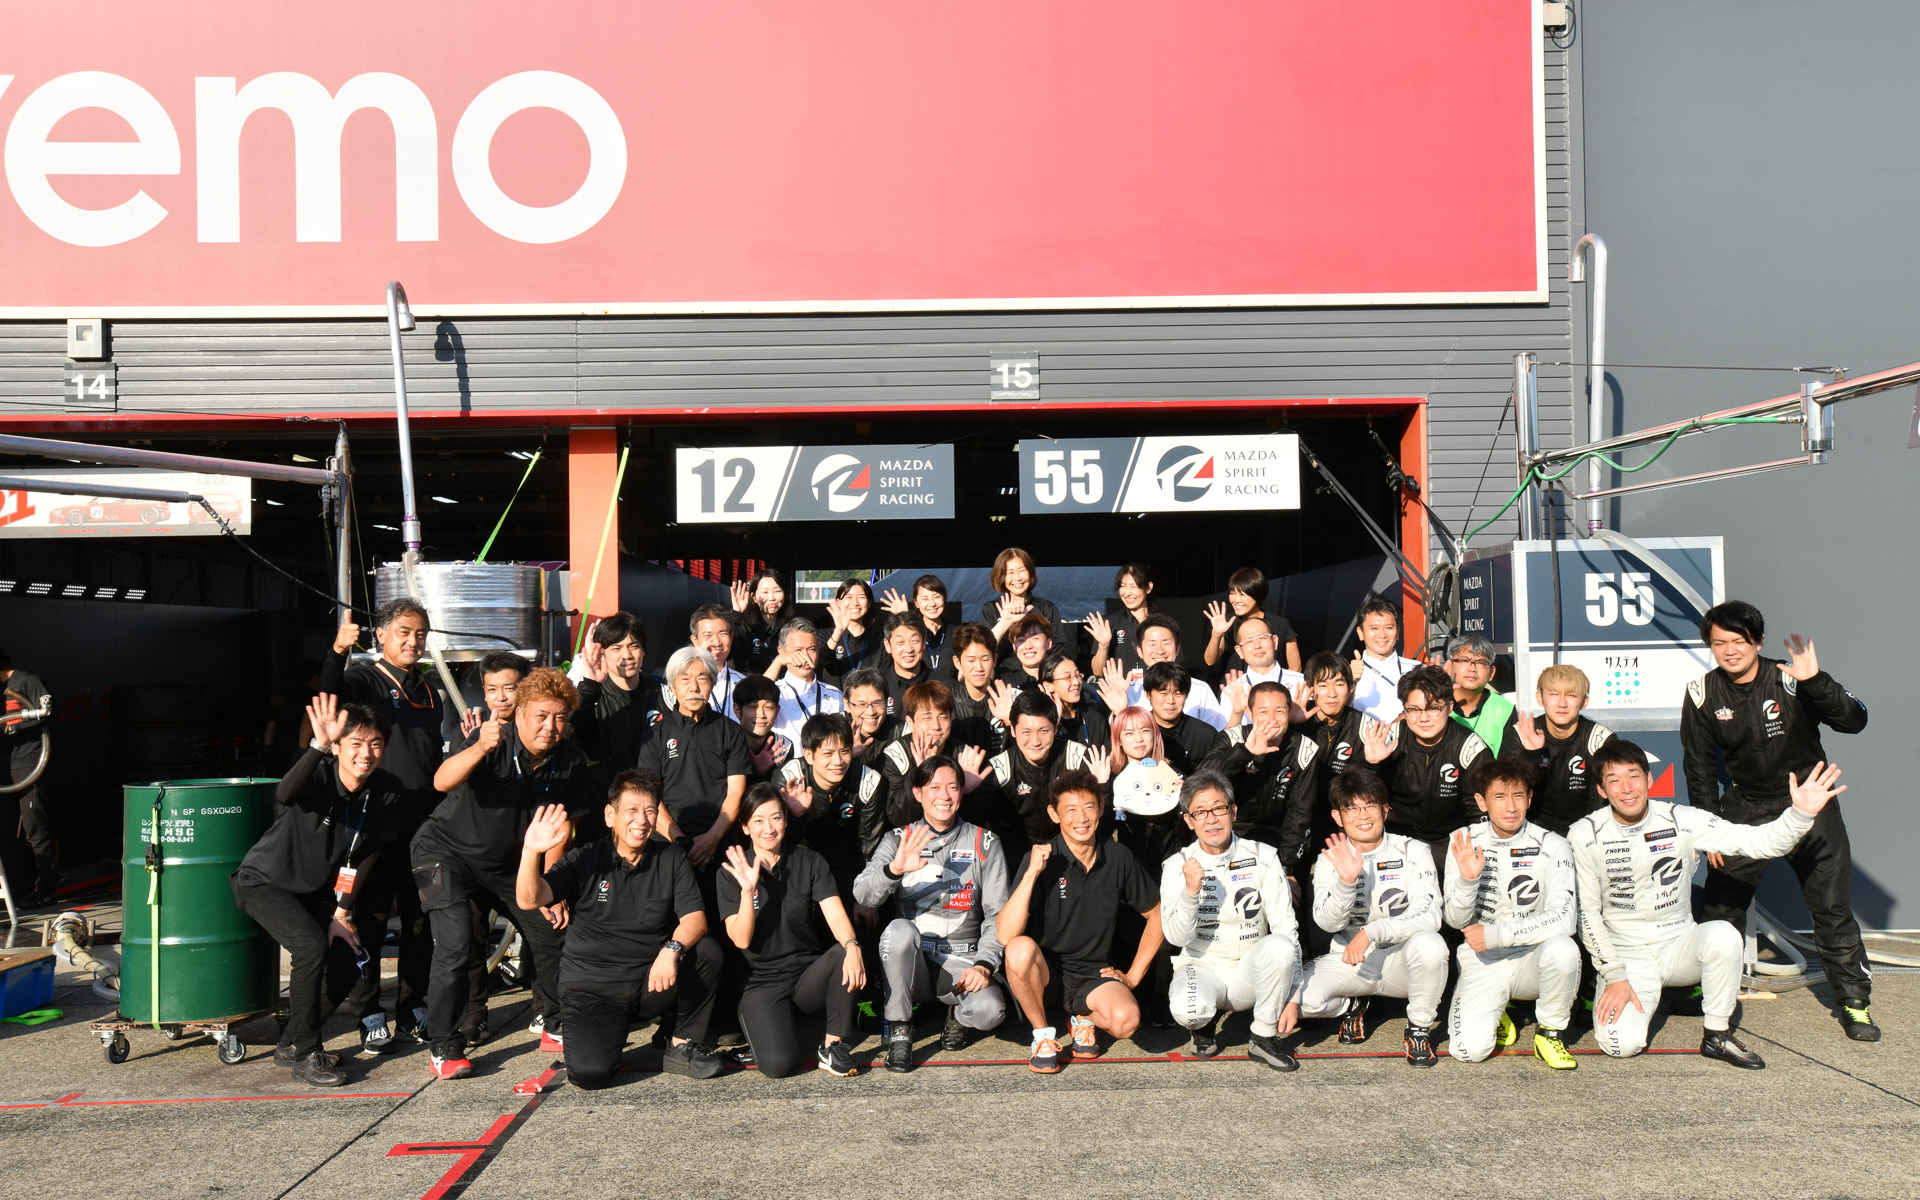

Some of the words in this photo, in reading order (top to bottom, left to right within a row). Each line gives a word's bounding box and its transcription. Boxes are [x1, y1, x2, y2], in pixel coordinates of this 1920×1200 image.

[996, 363, 1033, 388] 15
[71, 374, 109, 398] 14
[1224, 450, 1278, 461] MAZDA
[879, 459, 934, 471] MAZDA
[1034, 449, 1104, 505] 55
[1225, 467, 1268, 478] SPIRIT
[691, 457, 756, 513] 12
[879, 476, 923, 488] SPIRIT
[1225, 483, 1280, 495] RACING
[879, 493, 935, 505] RACING
[1463, 576, 1483, 590] MAZDA
[1464, 597, 1479, 611] SPIRIT
[1585, 572, 1655, 627] 55
[1464, 618, 1485, 631] RACING
[182, 808, 195, 816] SP
[1513, 924, 1540, 937] MAZDA
[1540, 914, 1562, 928] SPIRIT
[1187, 982, 1197, 1015] SPIRIT
[1454, 996, 1462, 1037] MAZDA
[1609, 1029, 1621, 1056] SPIR
